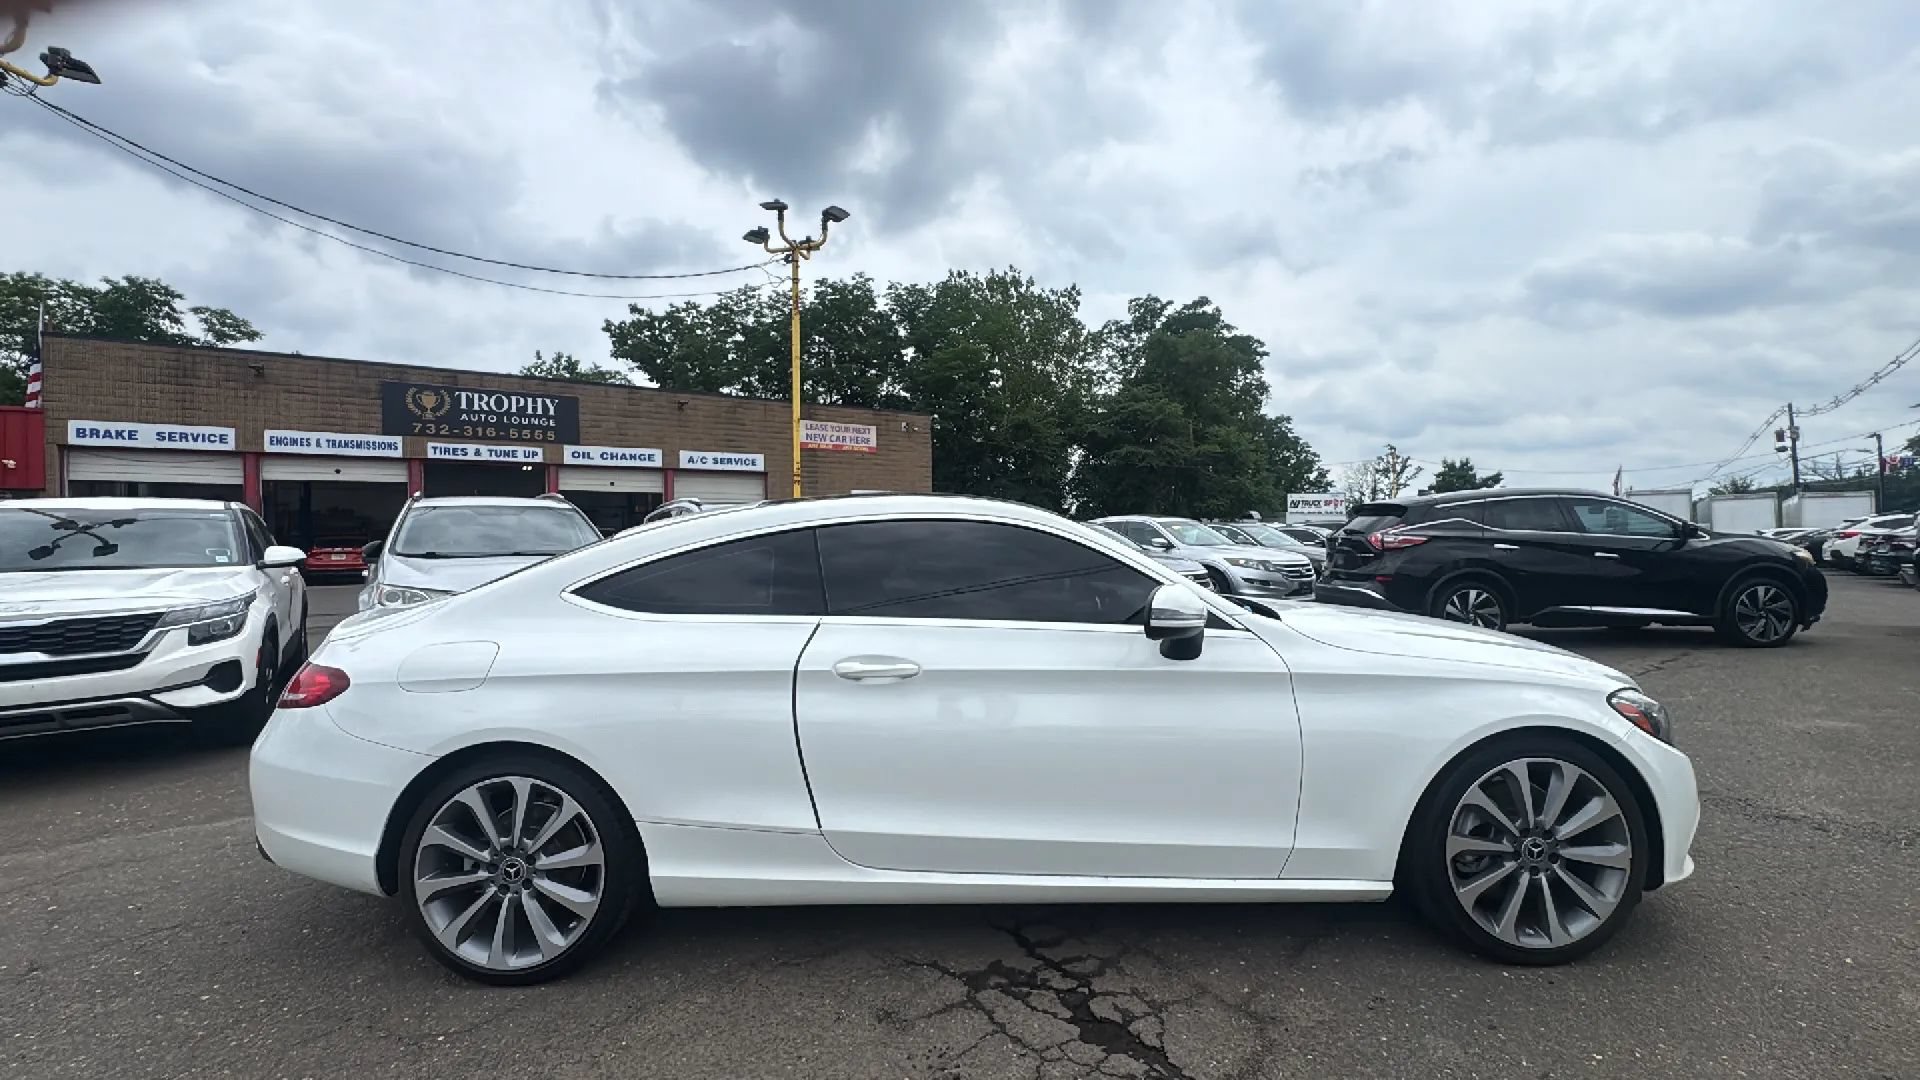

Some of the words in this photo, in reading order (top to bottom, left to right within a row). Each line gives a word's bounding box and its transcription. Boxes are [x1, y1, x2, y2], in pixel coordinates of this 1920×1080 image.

[454, 391, 559, 416] TROPHY
[459, 413, 498, 423] AUTO
[504, 415, 556, 427] LOUNGE
[75, 427, 139, 441] BRAKE
[155, 431, 229, 445] SERVICE
[805, 423, 829, 432] LEASE
[830, 425, 851, 433] YOUR
[852, 427, 871, 435] NEXT
[269, 436, 311, 448] ENGINES
[315, 438, 322, 448] &
[326, 439, 399, 451] TRANSMISSIONS
[805, 433, 827, 442] NEW
[829, 434, 847, 443] CAR
[849, 436, 871, 445] HERE
[431, 445, 469, 457] TIRES
[474, 447, 482, 457] &
[487, 448, 519, 458] TUNE
[523, 450, 539, 459] UP
[571, 450, 595, 460] OIL
[599, 451, 657, 463] CHANGE
[687, 456, 708, 466] A/C
[712, 457, 757, 467] SERVICE
